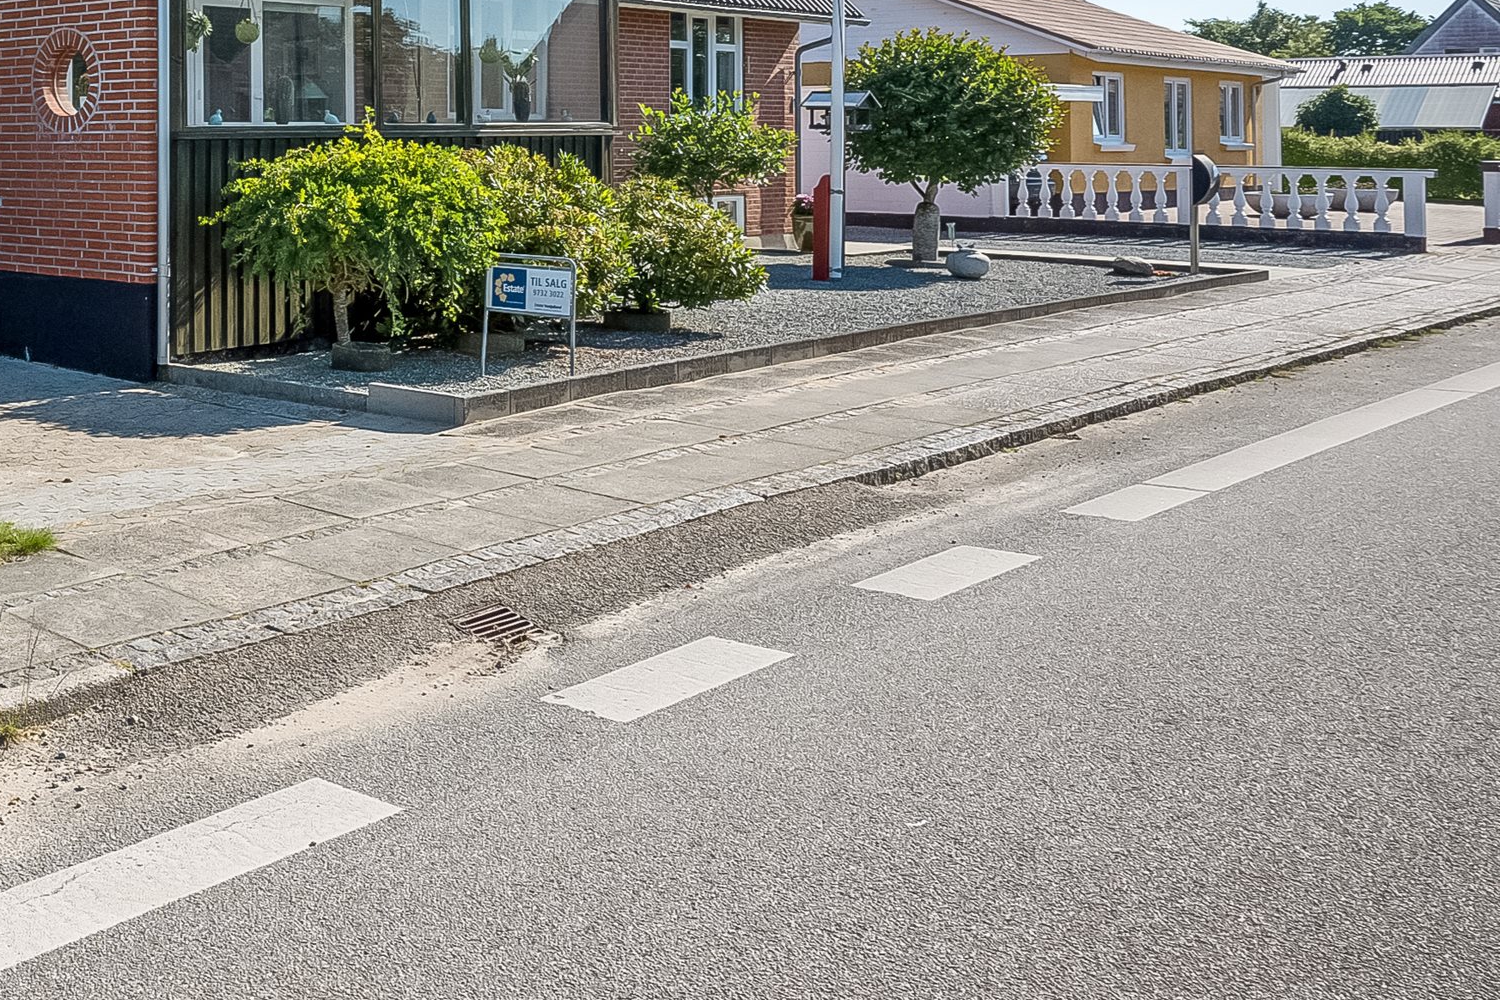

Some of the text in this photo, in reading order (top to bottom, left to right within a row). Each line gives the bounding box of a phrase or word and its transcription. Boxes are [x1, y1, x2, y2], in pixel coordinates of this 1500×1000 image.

[503, 283, 524, 294] Estate
[531, 277, 567, 289] TIL SALG
[533, 289, 547, 297] 9732
